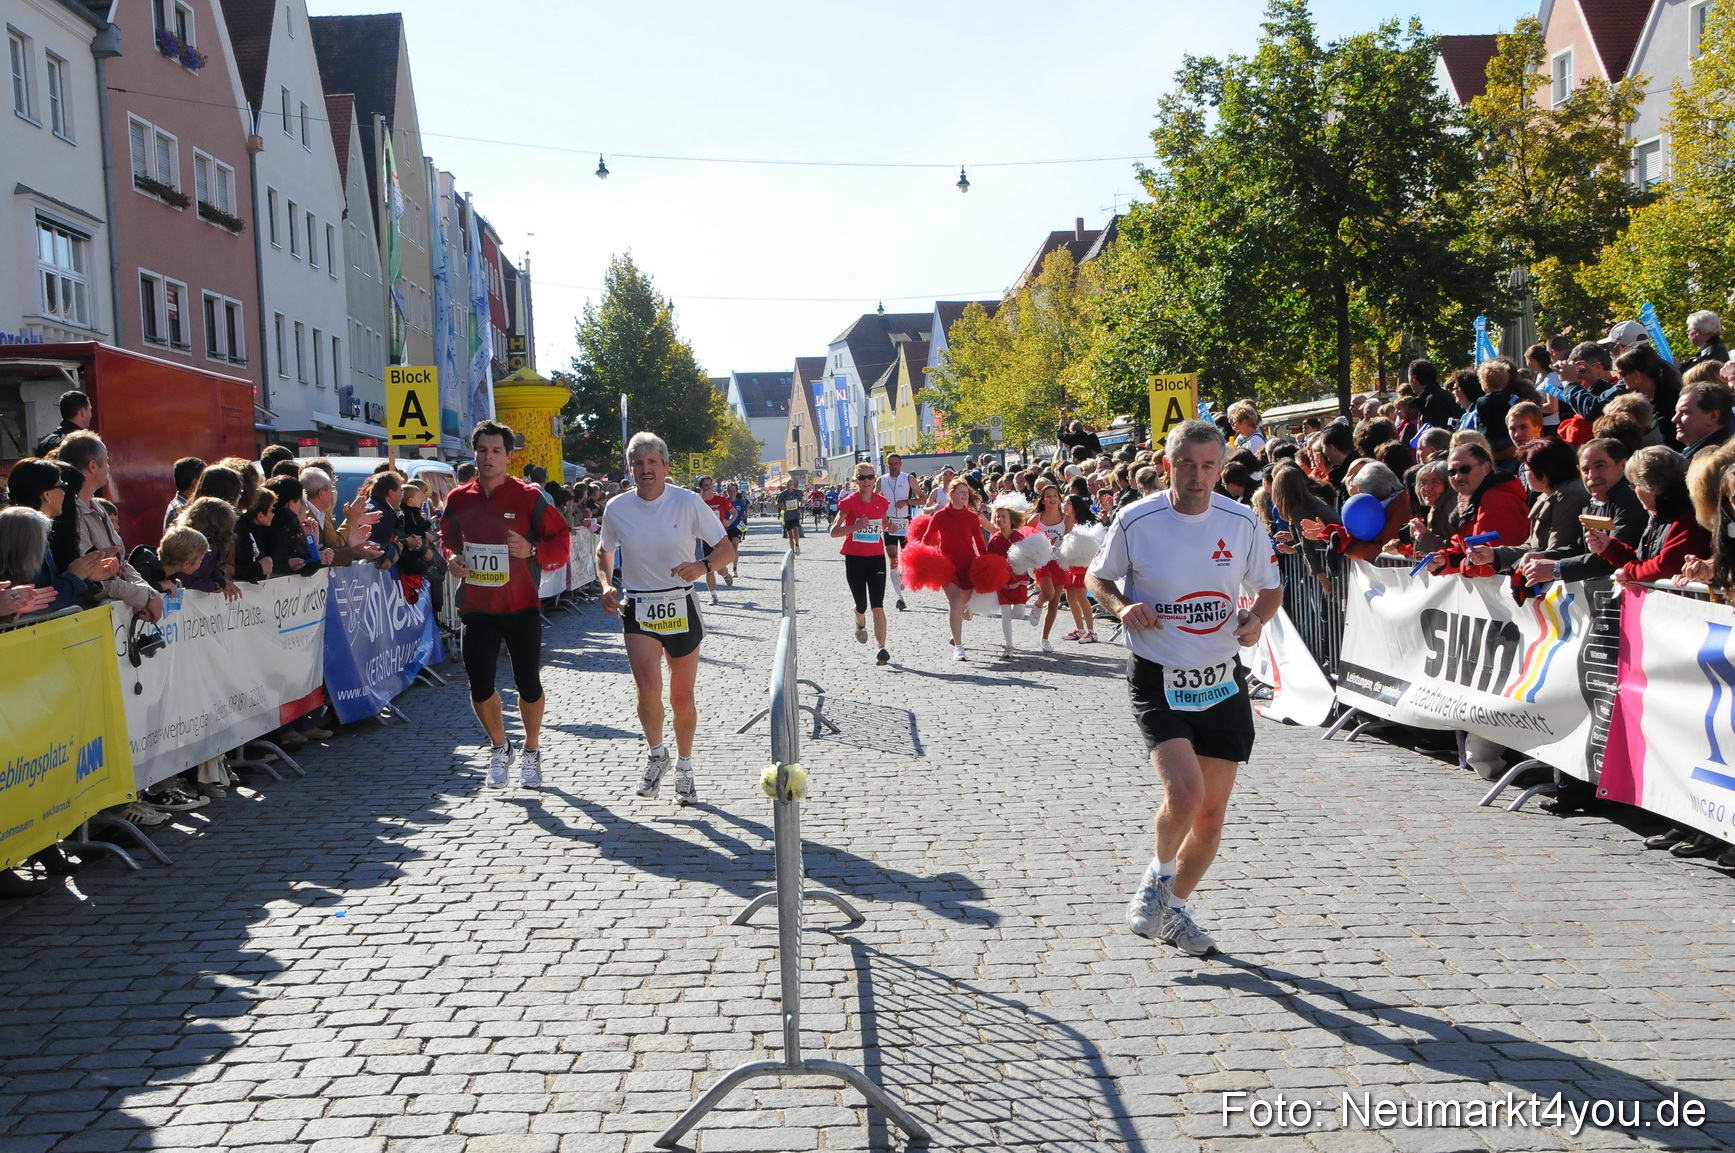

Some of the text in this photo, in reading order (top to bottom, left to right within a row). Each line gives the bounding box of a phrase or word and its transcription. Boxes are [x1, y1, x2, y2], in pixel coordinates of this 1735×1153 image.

[391, 370, 431, 384] Block
[1155, 379, 1192, 392] Block
[398, 390, 429, 427] A
[1162, 397, 1185, 433] A
[693, 459, 700, 469] B
[472, 555, 499, 571] 170
[469, 570, 504, 582] Christoph
[647, 602, 676, 620] 466
[1155, 601, 1220, 614] GERHART
[642, 618, 682, 630] Bernhard
[1186, 609, 1226, 624] JÄNIG
[1590, 650, 1608, 659] Wasser
[1173, 662, 1227, 688] 3387
[1174, 686, 1230, 703] Hermann
[1409, 685, 1554, 736] stadtwerke neumarkt
[1690, 793, 1725, 822] MICRO
